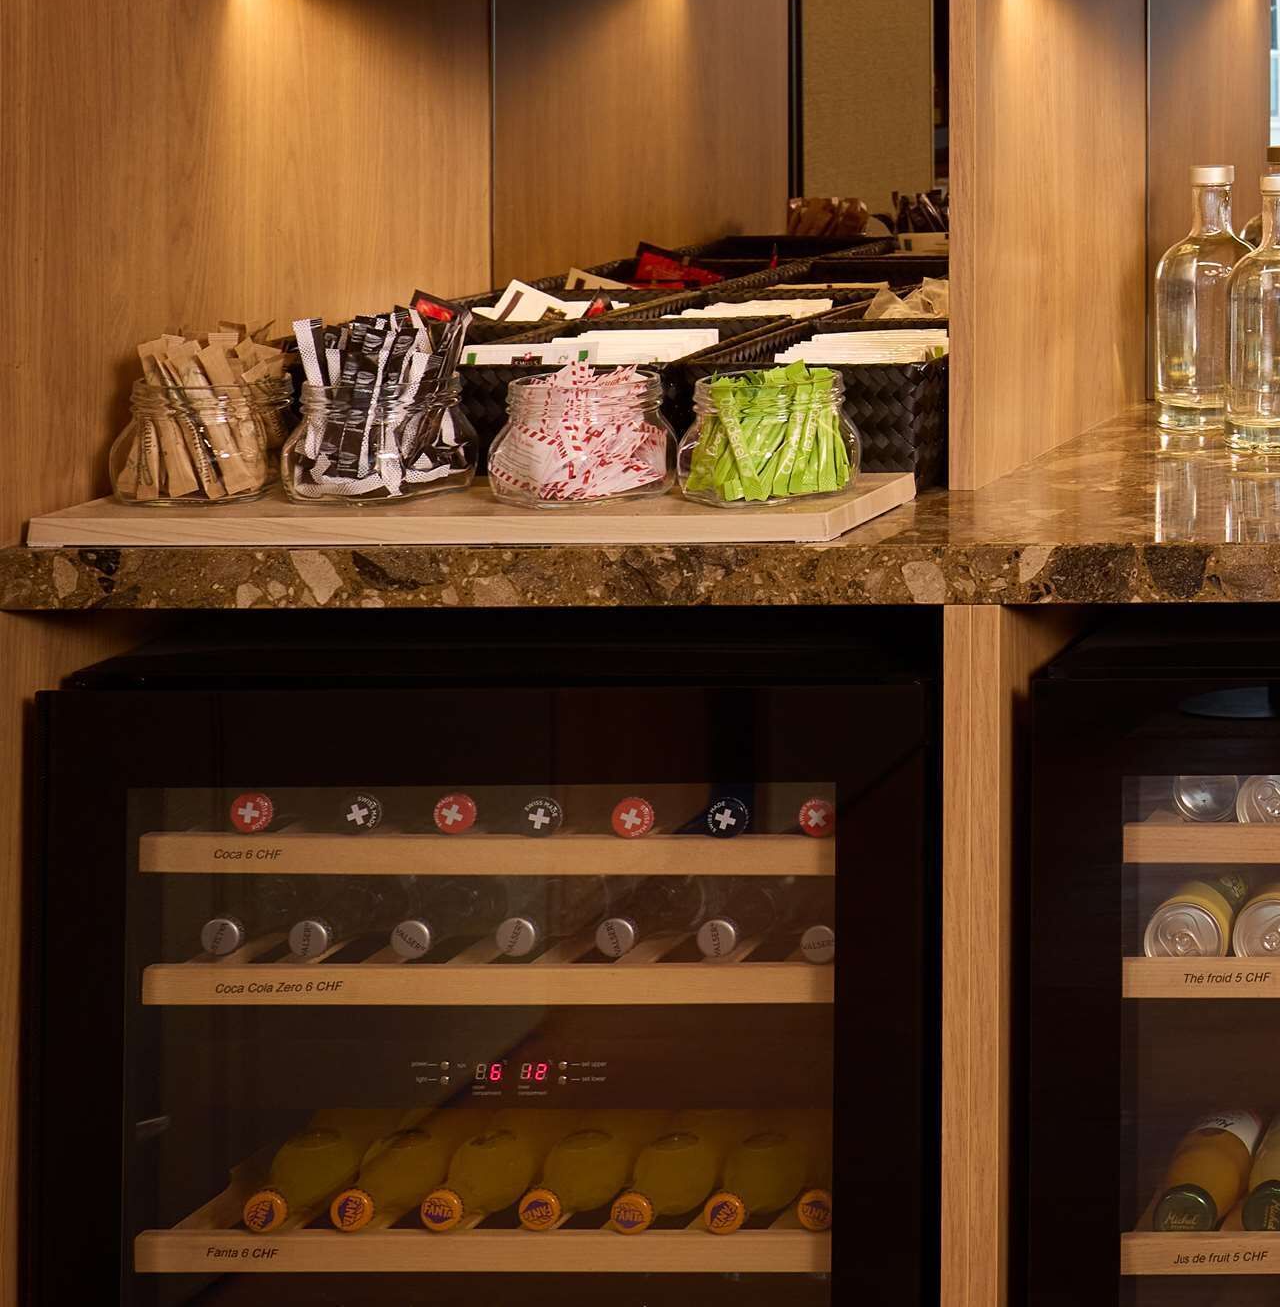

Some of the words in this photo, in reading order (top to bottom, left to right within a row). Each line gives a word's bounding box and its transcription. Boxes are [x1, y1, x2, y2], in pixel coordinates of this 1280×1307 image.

[357, 796, 376, 810] SWISS
[524, 799, 543, 812] SWISS
[708, 814, 718, 834] SWISS
[214, 848, 242, 860] Coca
[245, 849, 252, 859] 6
[256, 849, 283, 860] CHF
[1207, 973, 1232, 983] froid
[1235, 973, 1242, 983] 5
[1246, 972, 1271, 983] CHF
[215, 983, 244, 994] Coca
[247, 982, 273, 993] Cola
[276, 982, 303, 993] Zero
[305, 982, 312, 992] 6
[316, 980, 344, 992] CHF
[489, 1063, 502, 1081] 6
[422, 1202, 453, 1219] FANTA
[612, 1207, 645, 1223] FANTA
[1163, 1211, 1198, 1226] Michel
[206, 1248, 238, 1259] Fanta
[241, 1248, 249, 1258] 6
[252, 1248, 279, 1259] CHF
[1174, 1253, 1189, 1265] Jus
[1192, 1253, 1206, 1263] de
[1208, 1251, 1230, 1263] fruit
[1233, 1252, 1240, 1262] 5
[1242, 1251, 1268, 1262] CHF
